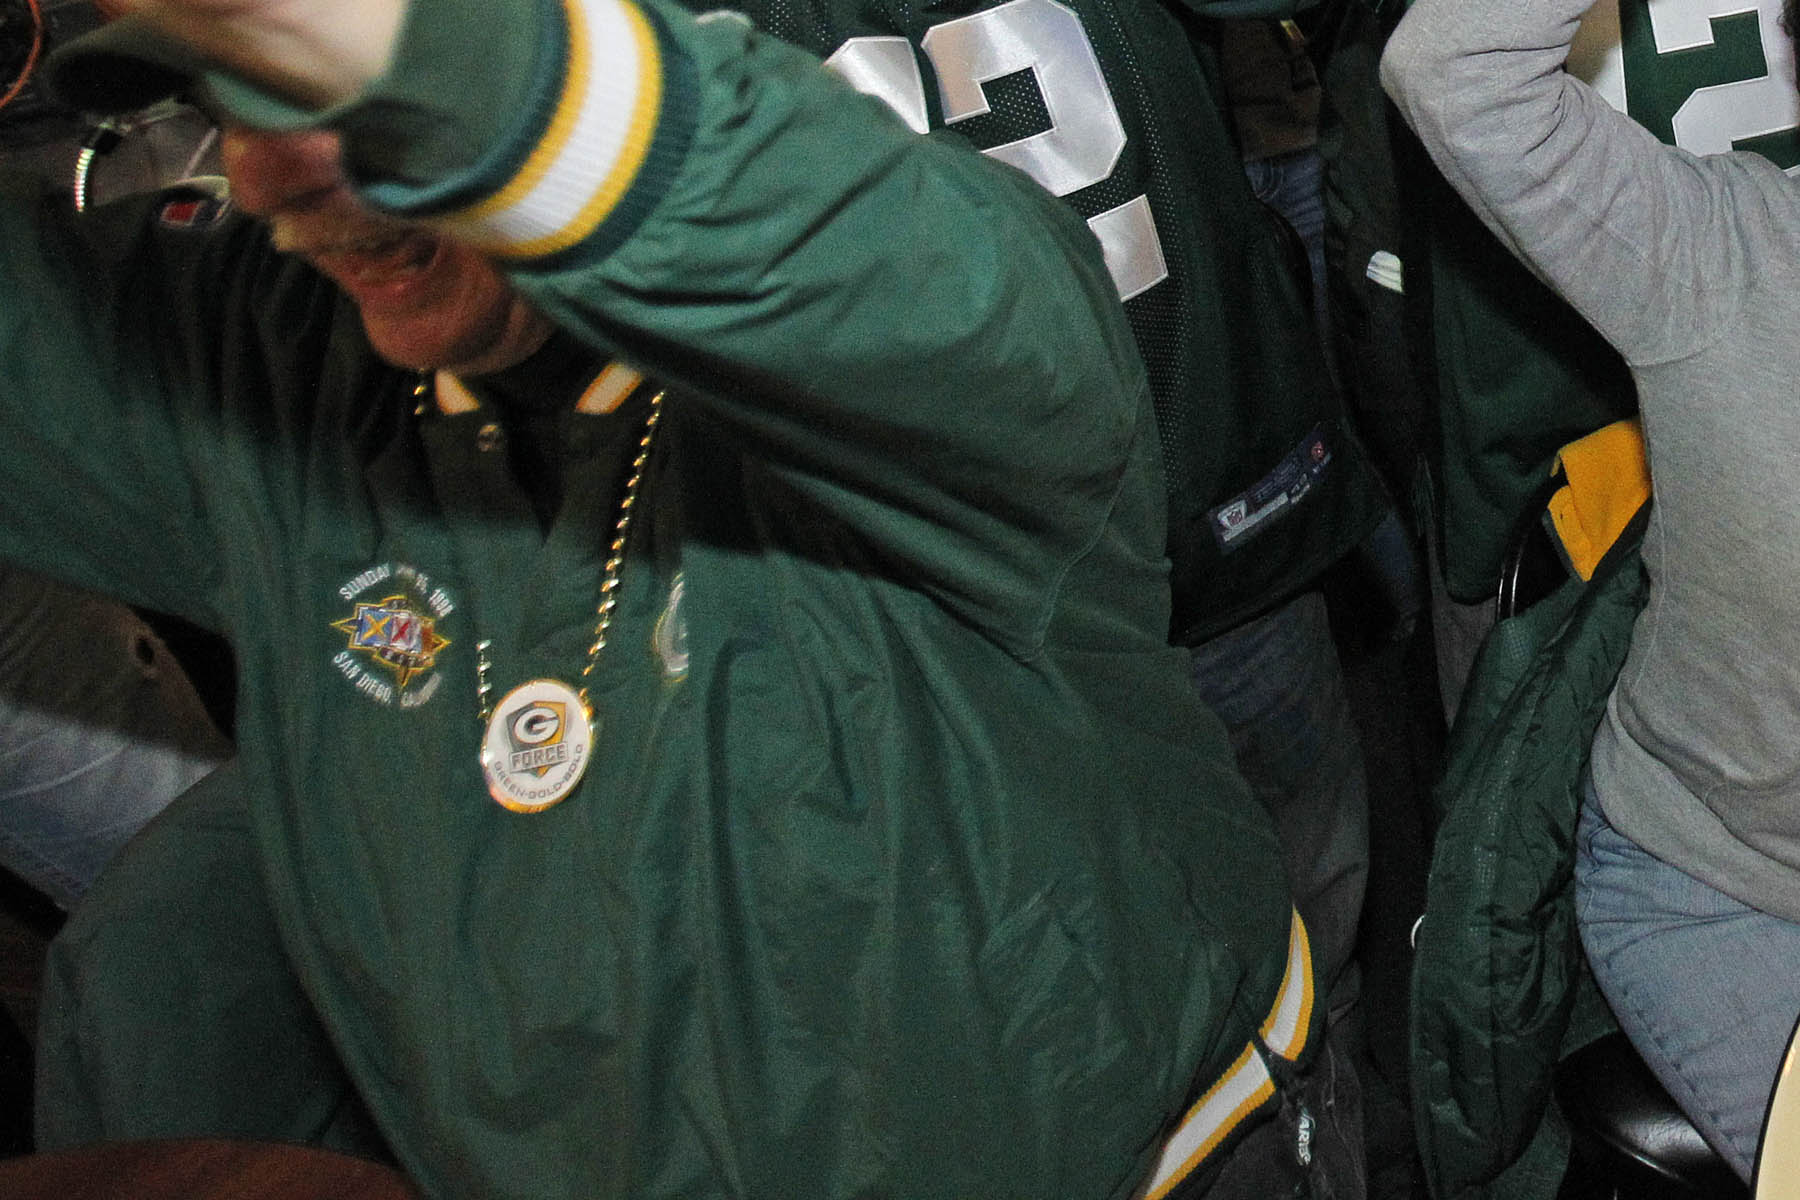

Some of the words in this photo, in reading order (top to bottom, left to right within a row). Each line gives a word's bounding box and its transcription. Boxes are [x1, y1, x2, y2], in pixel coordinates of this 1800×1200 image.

[339, 562, 391, 601] SUNDAY
[333, 651, 361, 680] SAN
[513, 706, 560, 744] G
[510, 744, 567, 771] FORCE
